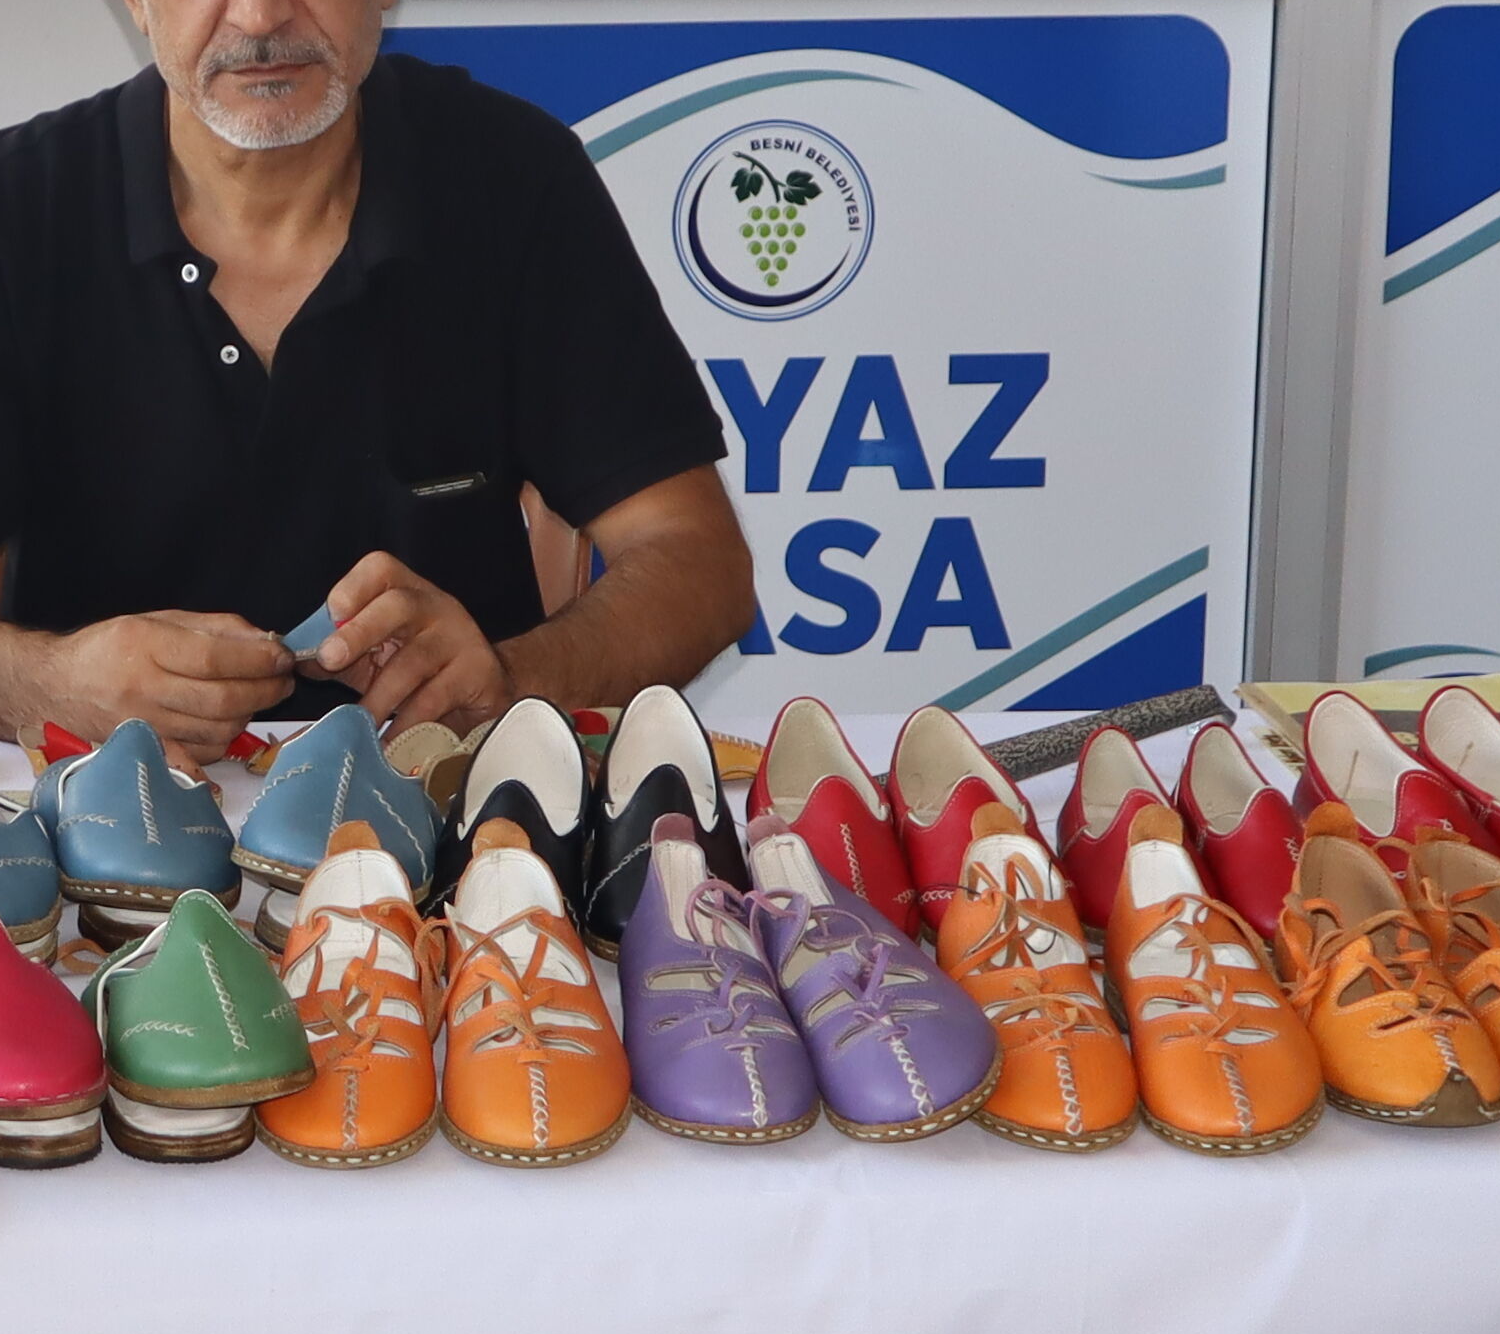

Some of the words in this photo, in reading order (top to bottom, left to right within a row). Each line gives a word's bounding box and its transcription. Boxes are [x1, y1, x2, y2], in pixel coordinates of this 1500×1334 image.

[751, 137, 803, 154] BESNİ
[805, 147, 861, 232] BELEDİYESİ
[695, 353, 1050, 494] YAZ
